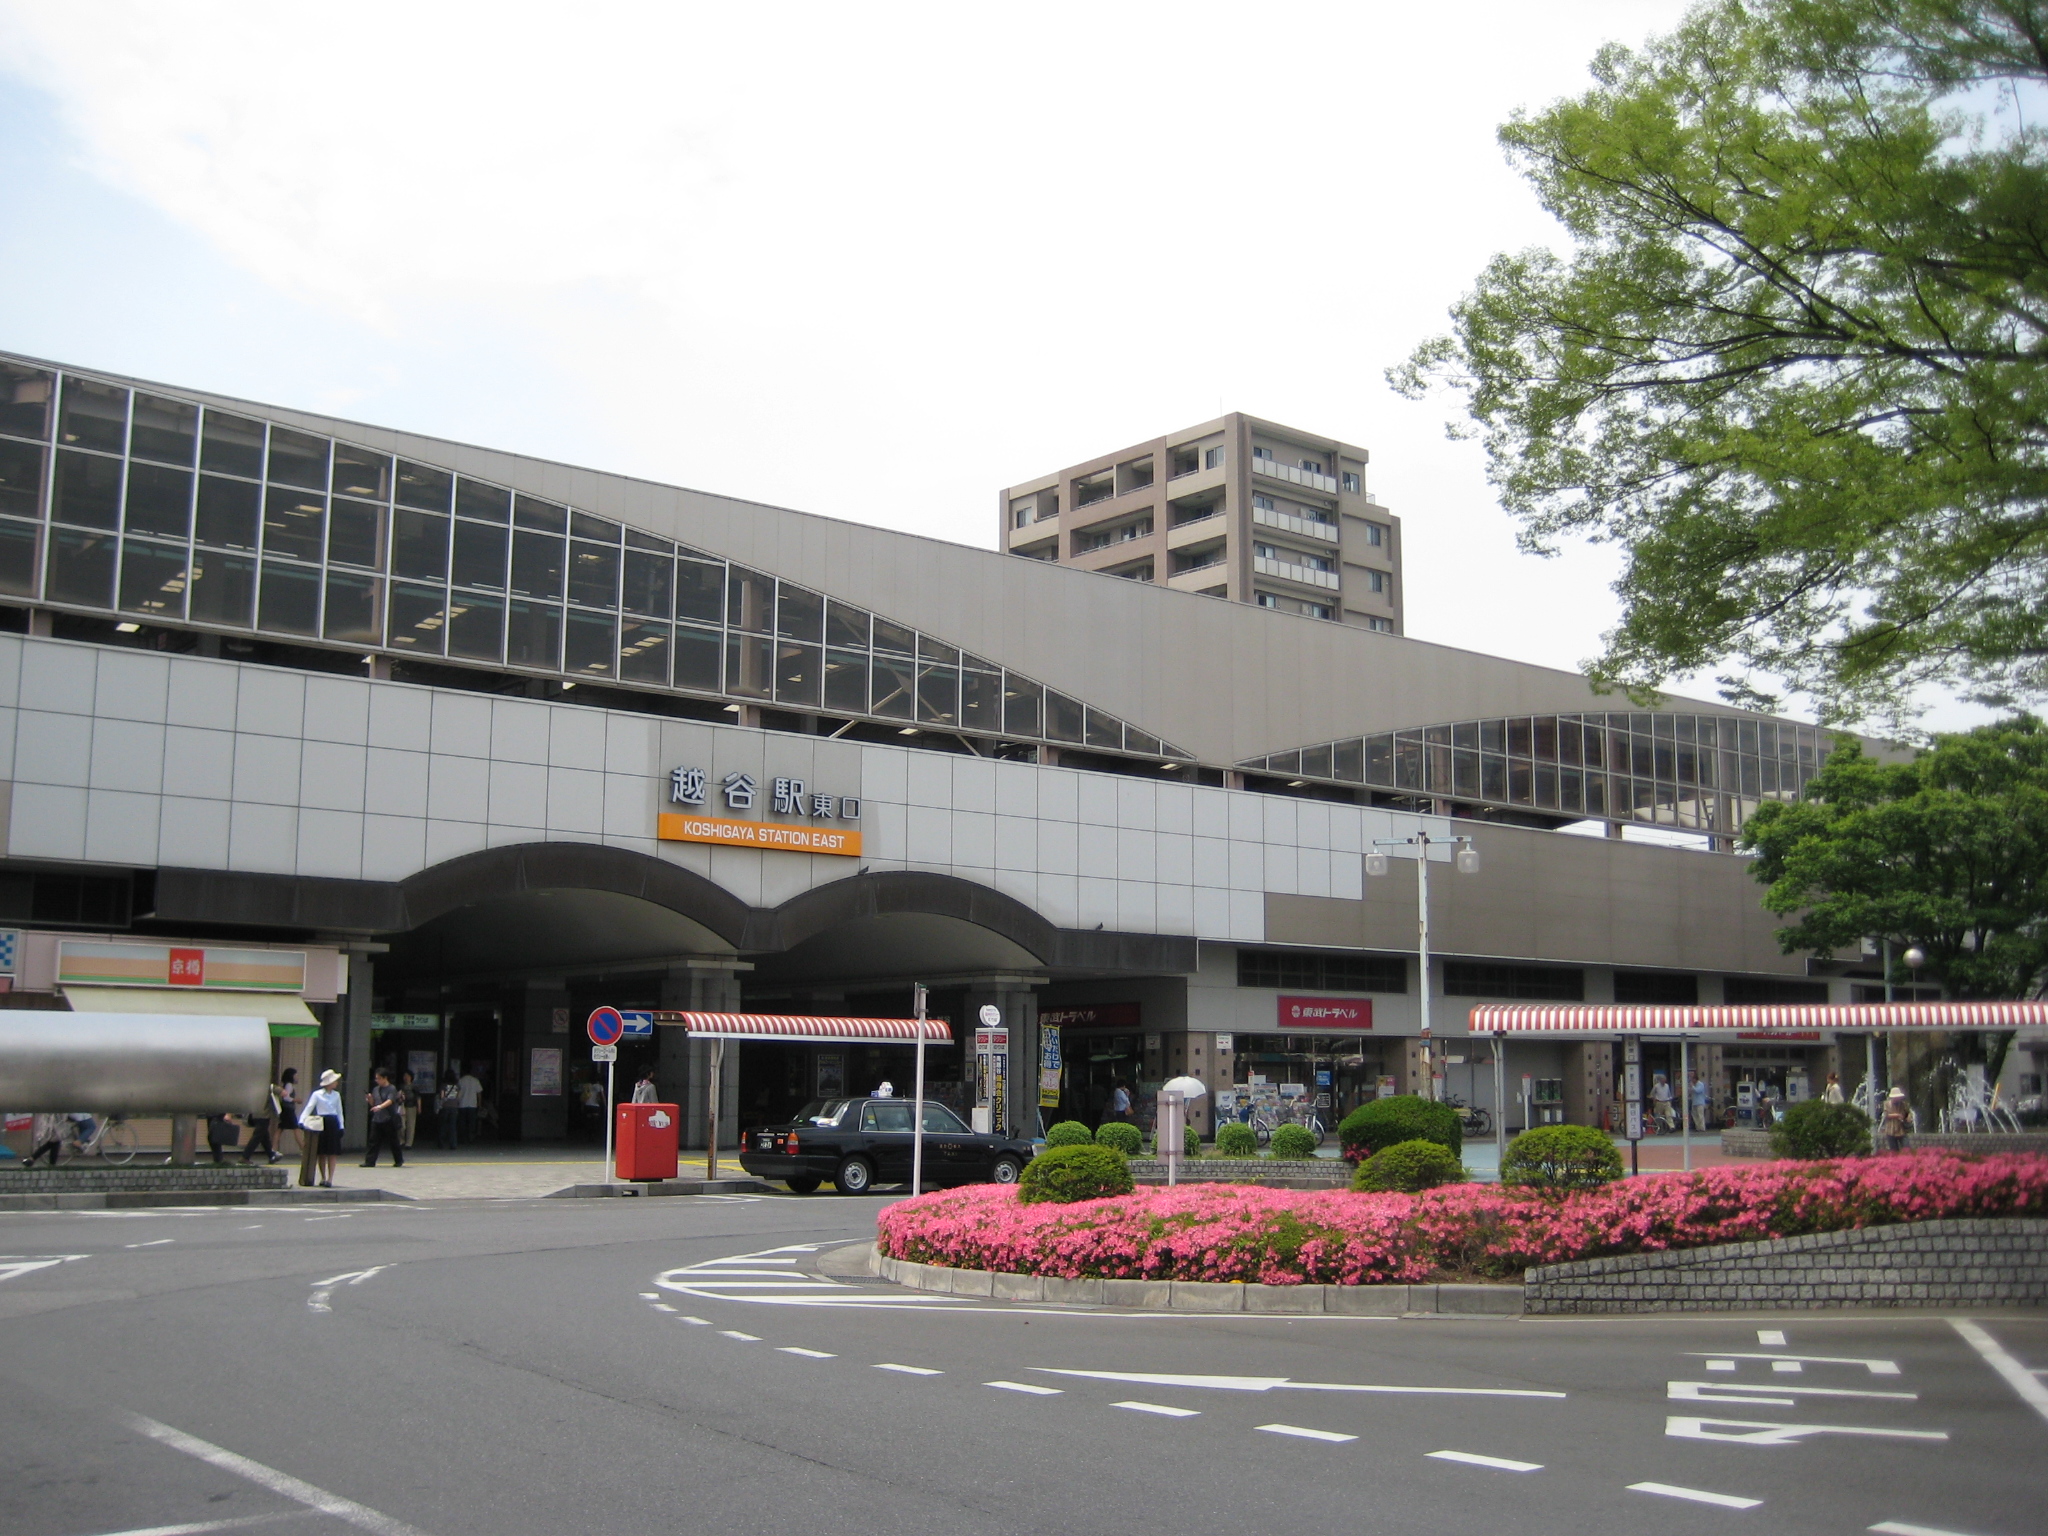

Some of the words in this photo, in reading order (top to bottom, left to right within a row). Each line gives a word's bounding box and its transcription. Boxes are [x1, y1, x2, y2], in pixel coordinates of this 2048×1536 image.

[684, 820, 755, 842] KOSHIGAYA
[758, 828, 810, 846] STATION
[812, 833, 845, 849] EAST
[1302, 1006, 1359, 1019] 東武トラベル
